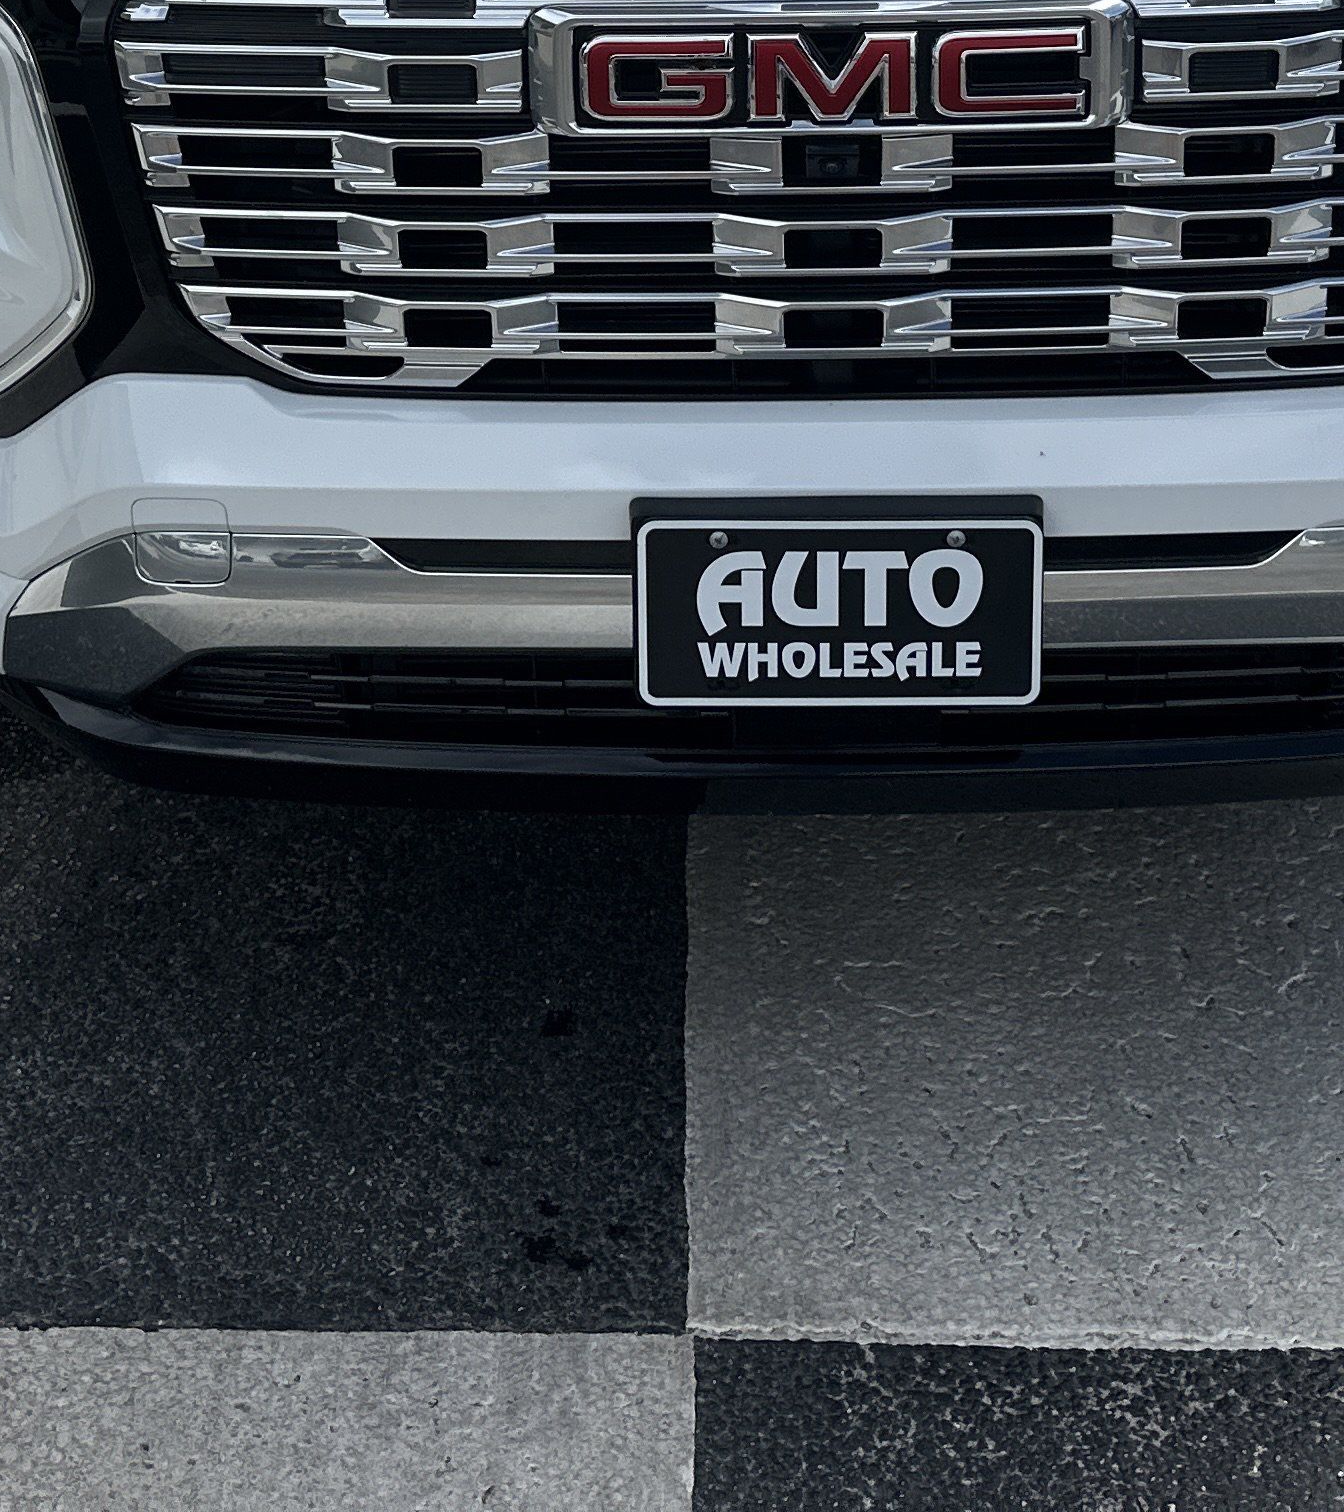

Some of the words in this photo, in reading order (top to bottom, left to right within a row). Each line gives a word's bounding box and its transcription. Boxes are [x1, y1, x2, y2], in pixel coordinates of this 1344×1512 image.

[580, 26, 1087, 122] GMC
[696, 548, 984, 636] AUTO
[696, 641, 983, 682] WHOLESALE
